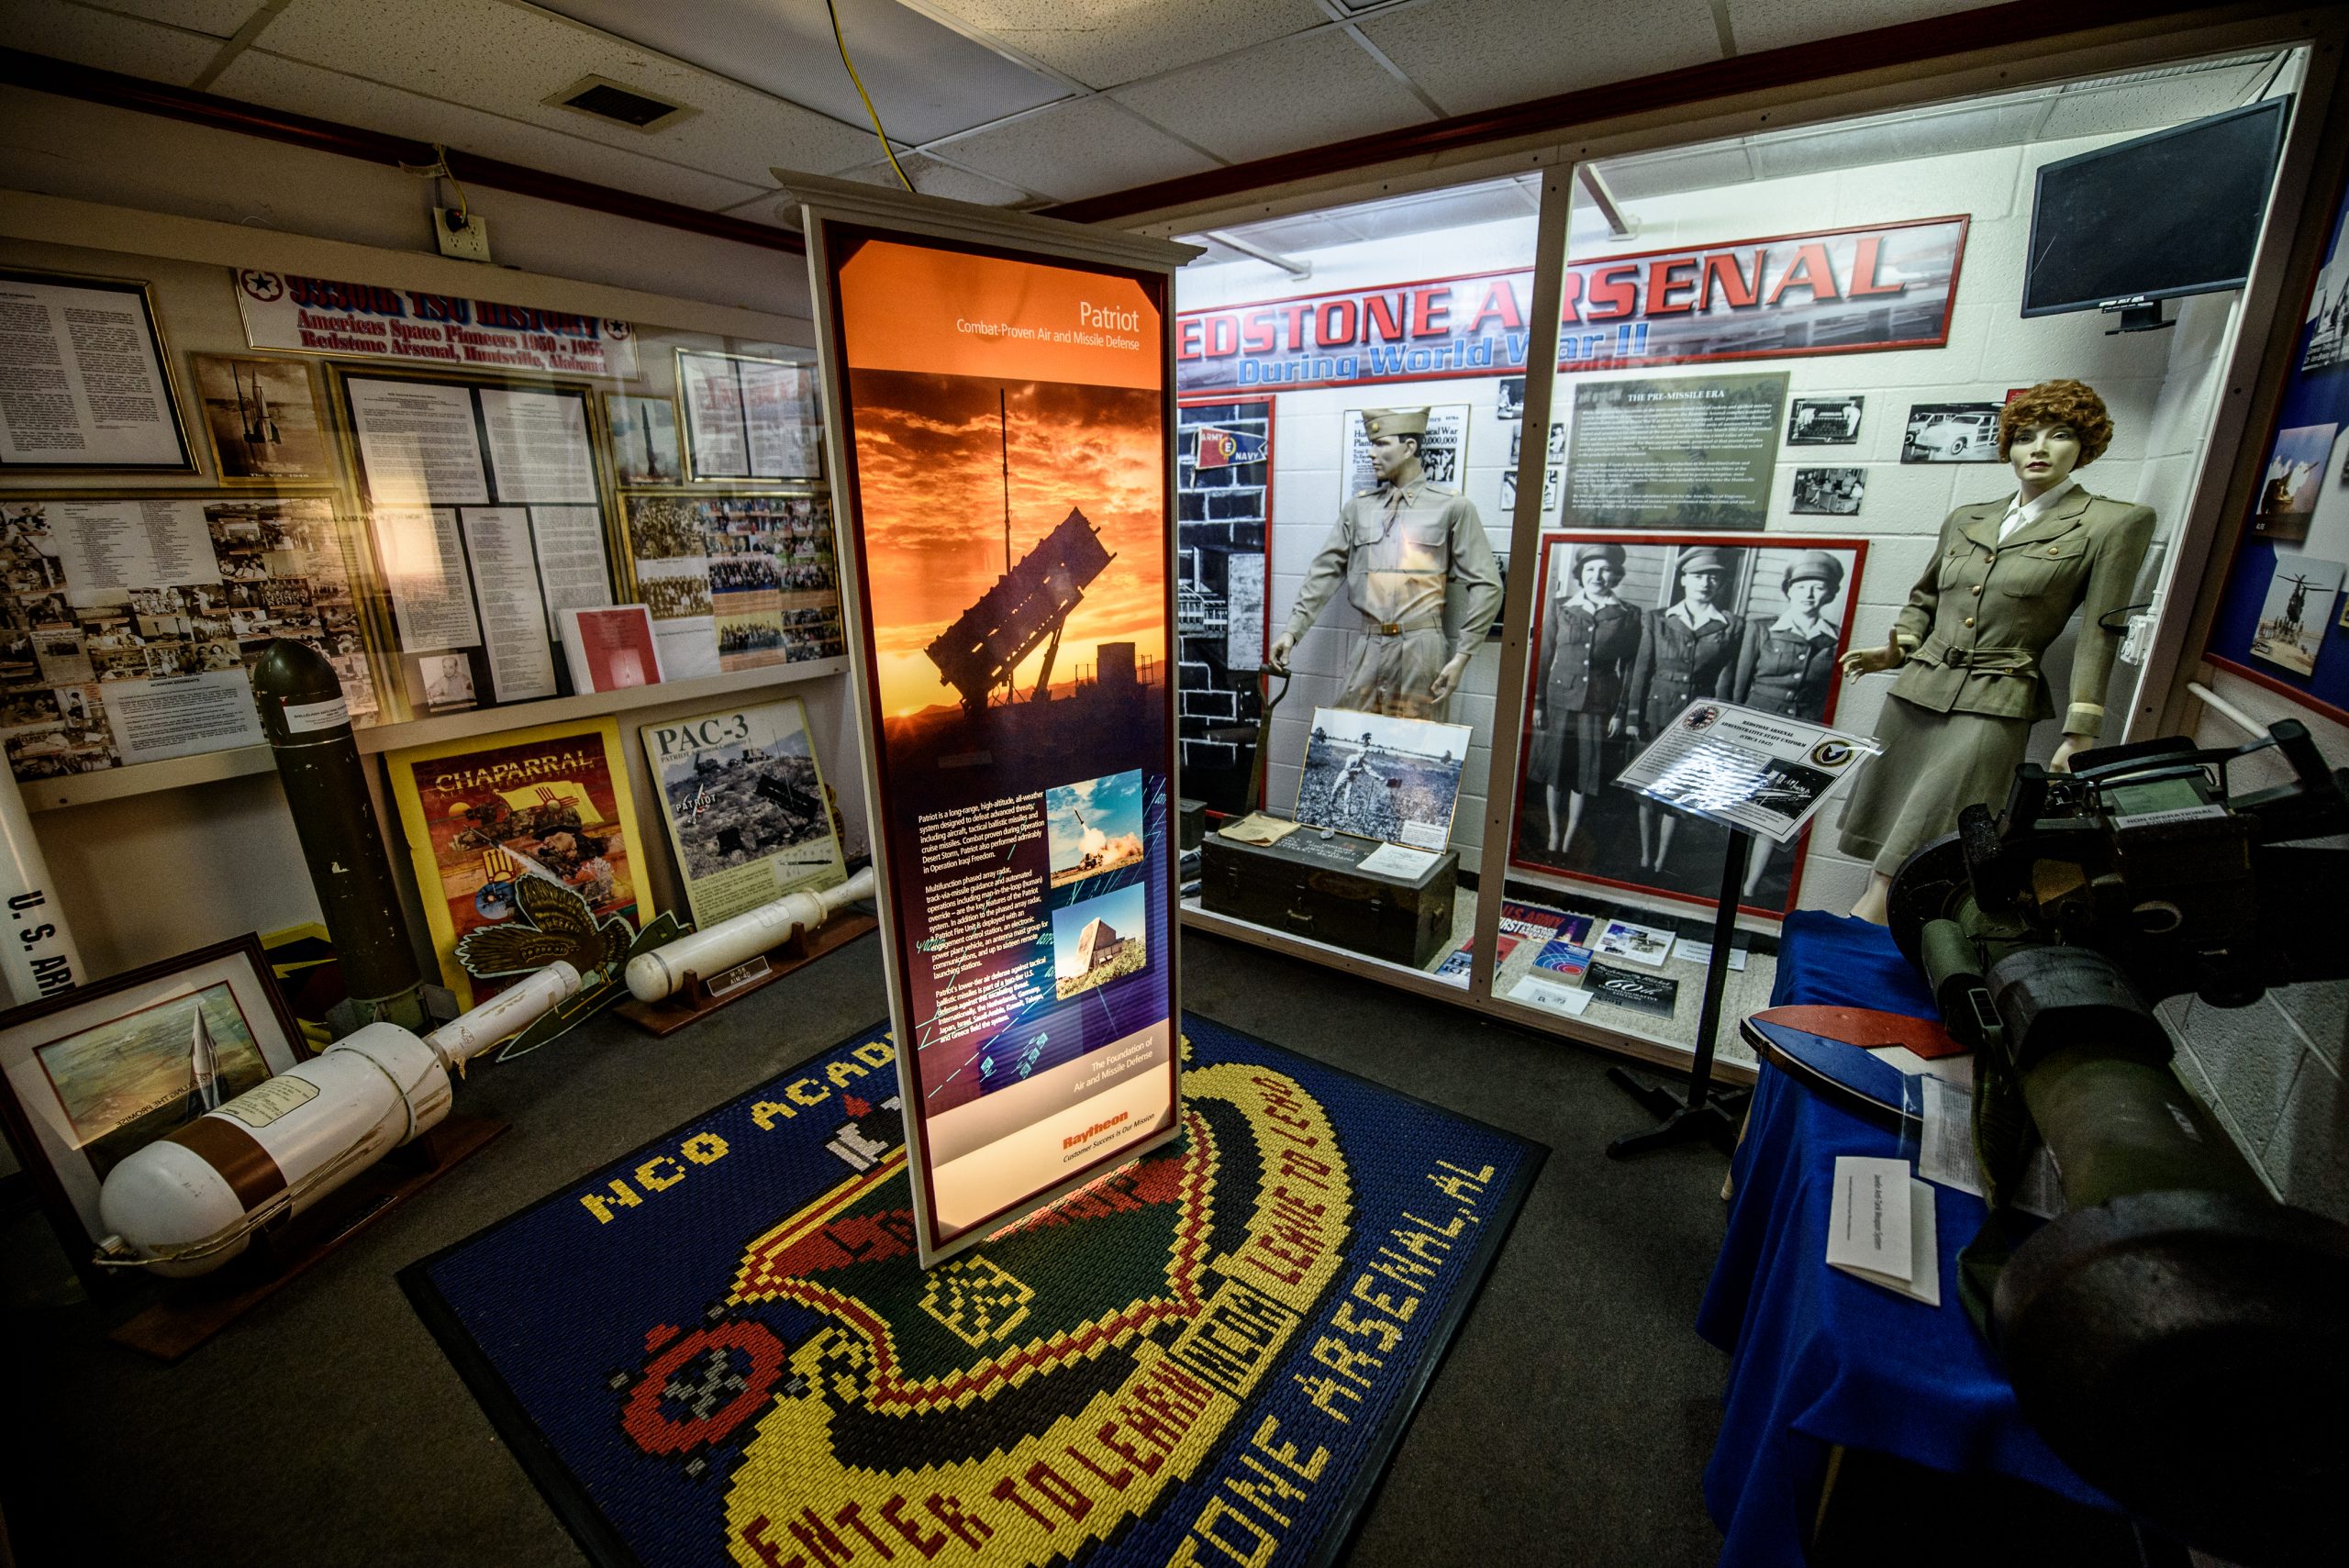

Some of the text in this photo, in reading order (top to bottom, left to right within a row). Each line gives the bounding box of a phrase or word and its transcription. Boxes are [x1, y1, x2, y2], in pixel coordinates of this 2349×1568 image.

[297, 308, 605, 357] Americas Space Pioneers 1950 1955
[1080, 301, 1140, 333] Patriot
[1177, 286, 1452, 361] EDSTONE
[956, 318, 1140, 350] Combat-Proven Air and Missile Defense
[299, 329, 607, 375] Redstone Arsenal, Huntsville, Alabama
[1237, 352, 1360, 386] During
[1367, 336, 1495, 374] World
[1616, 321, 1651, 356] II
[1628, 390, 1725, 402] THE PRE-MISSILE ERA
[1200, 433, 1223, 441] ARMY
[1225, 442, 1232, 452] E
[1235, 451, 1259, 461] NAVY
[1442, 427, 1458, 435] War
[654, 714, 749, 755] PAC-3
[1721, 721, 1808, 749] ADMINISTRATIVE STAFF UNIFORM
[1742, 720, 1795, 737] REDSTONE ARSENAL
[436, 750, 593, 792] CHAPARRAL
[676, 794, 716, 813] PATRIOT
[918, 812, 938, 823] Patriot
[949, 806, 980, 817] long-range,
[981, 797, 1015, 811] high-altitude,
[1016, 792, 1043, 803] all-weather
[919, 824, 939, 835] system
[941, 817, 964, 828] designed
[973, 811, 989, 821] defeat
[990, 806, 1015, 817] advanced
[1016, 803, 1035, 812] threats,
[2148, 808, 2214, 822] OPERATIONAL
[920, 811, 1038, 843] including aircraft, tactical ballistic missiles and
[921, 820, 1044, 853] cruise missiles. Combat proven during Operation
[922, 853, 941, 863] Desert
[961, 844, 978, 855] Patriot
[991, 835, 1017, 850] performed
[1018, 830, 1041, 841] admirably
[930, 861, 957, 873] Operation
[958, 856, 970, 866] Iraqi
[971, 852, 996, 862] Freedom.
[925, 879, 962, 893] Multifunction
[963, 873, 982, 886] phased
[996, 867, 1011, 875] radar,
[926, 870, 1032, 903] track-via-missile guidance and automated
[928, 876, 1042, 914] operations including man-in-the-loop (human)
[1499, 917, 1523, 934] IRST
[1524, 910, 1566, 929] ARMY
[7, 890, 77, 1000] U.S. AR
[1092, 1036, 1153, 1072] The Foundation of
[1074, 1050, 1153, 1093] Air and Missile Defense
[580, 1031, 895, 1225] NCO ACAD
[1063, 1111, 1129, 1151] Raytheon
[1063, 1144, 1092, 1163] Customer
[1093, 1133, 1115, 1149] Success
[1122, 1124, 1132, 1134] Our
[1133, 1113, 1155, 1128] Mission
[740, 1492, 994, 1568] ENTER
[990, 1461, 1095, 1533] TO
[1065, 1360, 1215, 1493] LEARN
[1183, 1284, 1287, 1388] NCOA
[1280, 1150, 1332, 1189] TO
